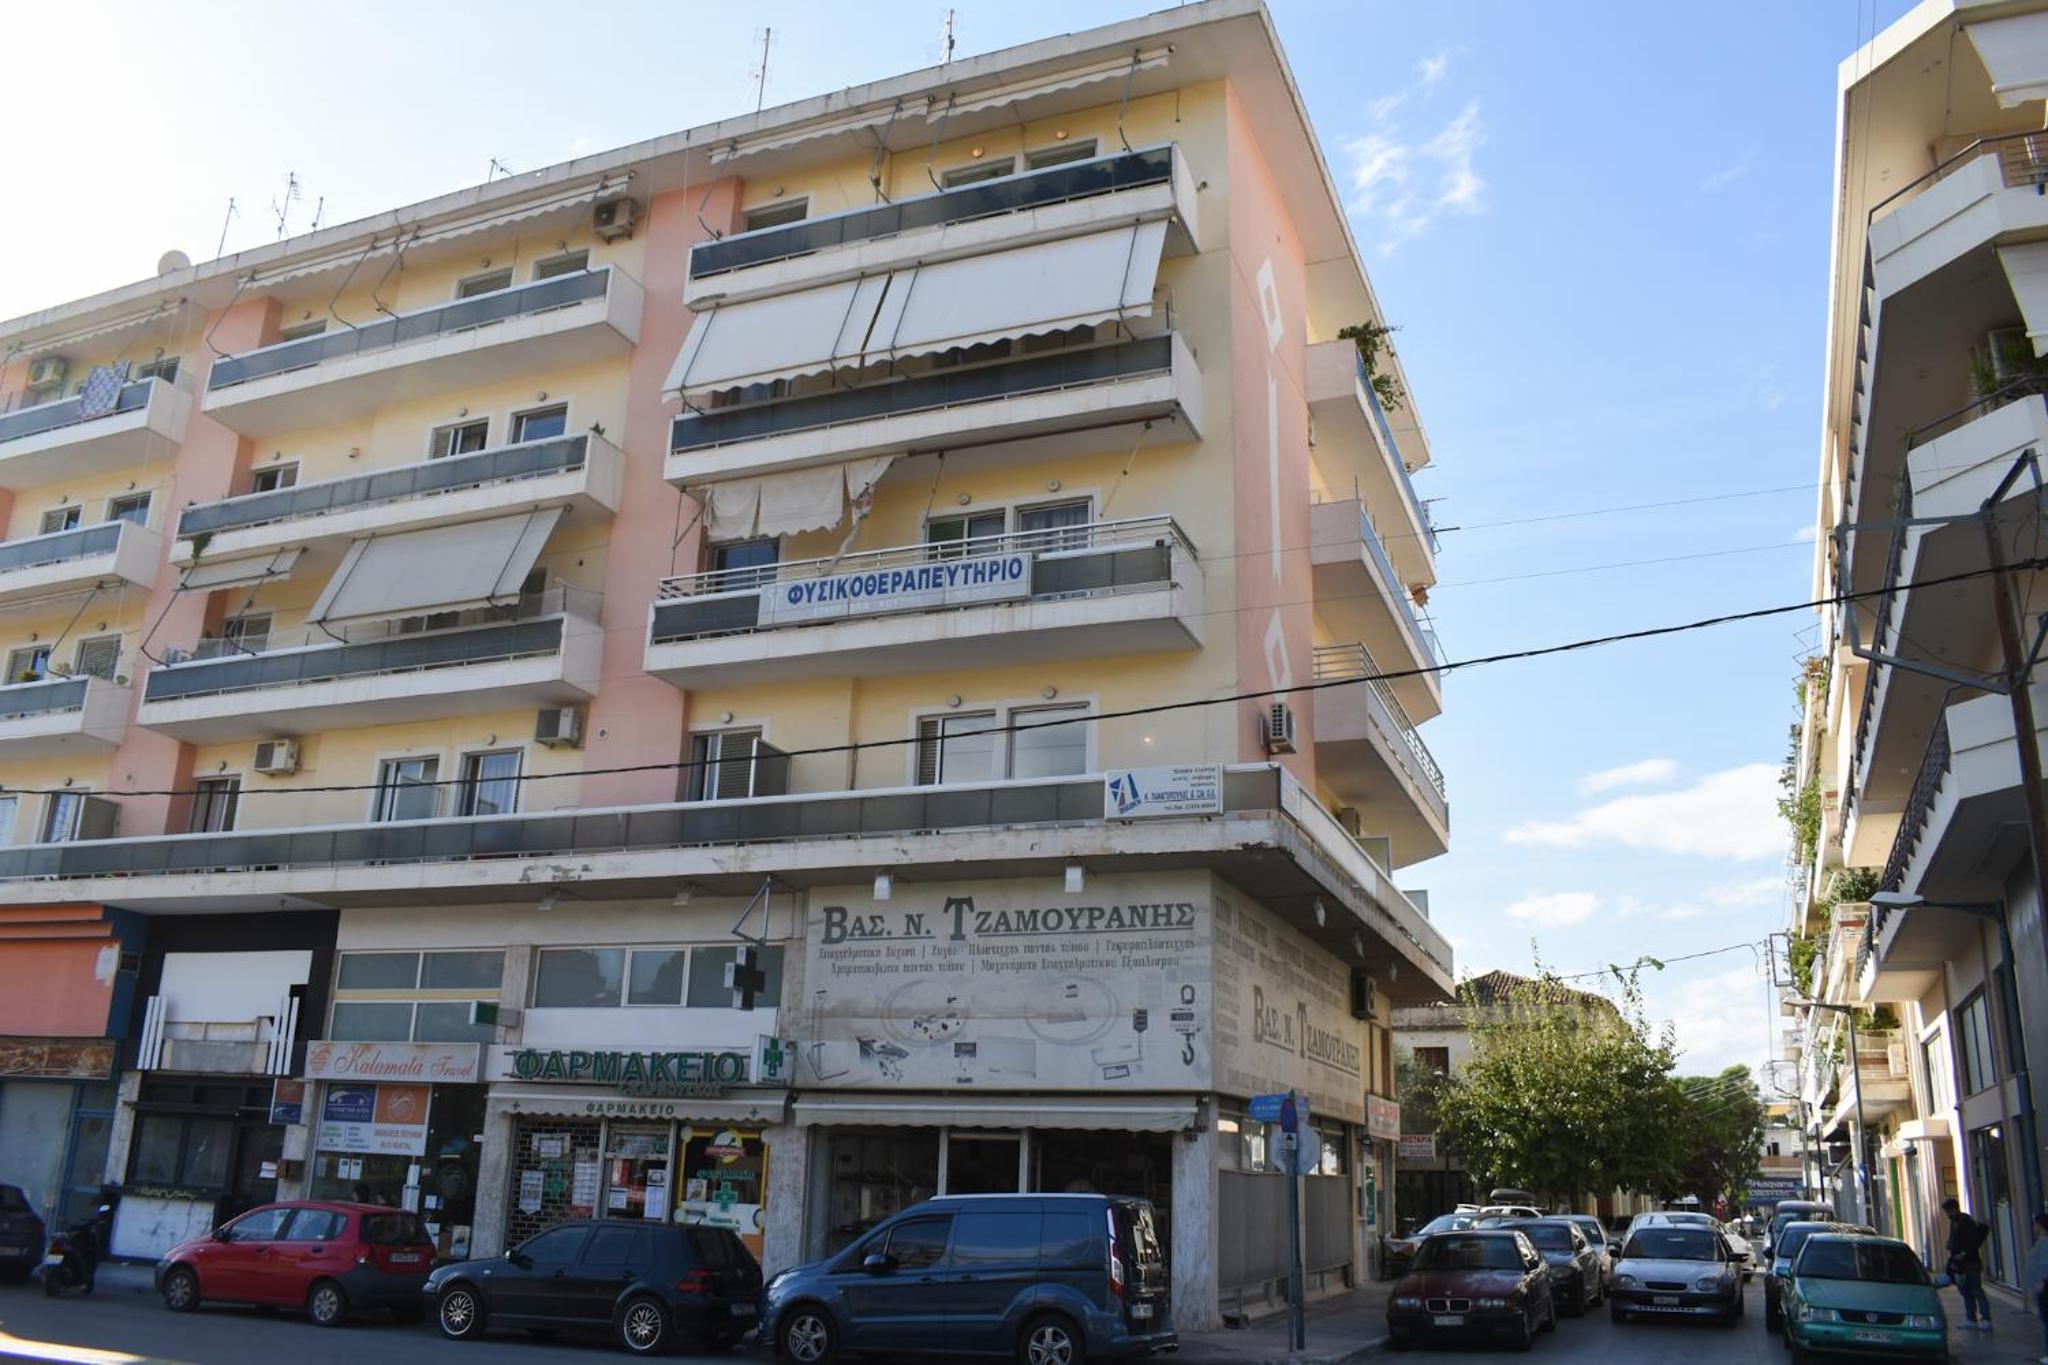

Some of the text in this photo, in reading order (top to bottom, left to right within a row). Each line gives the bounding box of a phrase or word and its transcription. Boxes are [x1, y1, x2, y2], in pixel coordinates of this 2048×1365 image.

[787, 557, 1023, 605] ΦΥΣΙΚΟΘΕΡΑΠΕΥΤΗΡΙΟ
[820, 906, 893, 944] ΒΑΣ.
[904, 913, 932, 936] Ν.
[943, 896, 1196, 941] ΤΖΑΜΟΥΡΑΝΗΣ
[334, 1046, 476, 1078] Kalamata Travel
[515, 1049, 746, 1085] ΦΑΡΜΑΚΕΙΟ
[586, 1103, 675, 1116] ΦΑΡΜΑΚΕΙΟ
